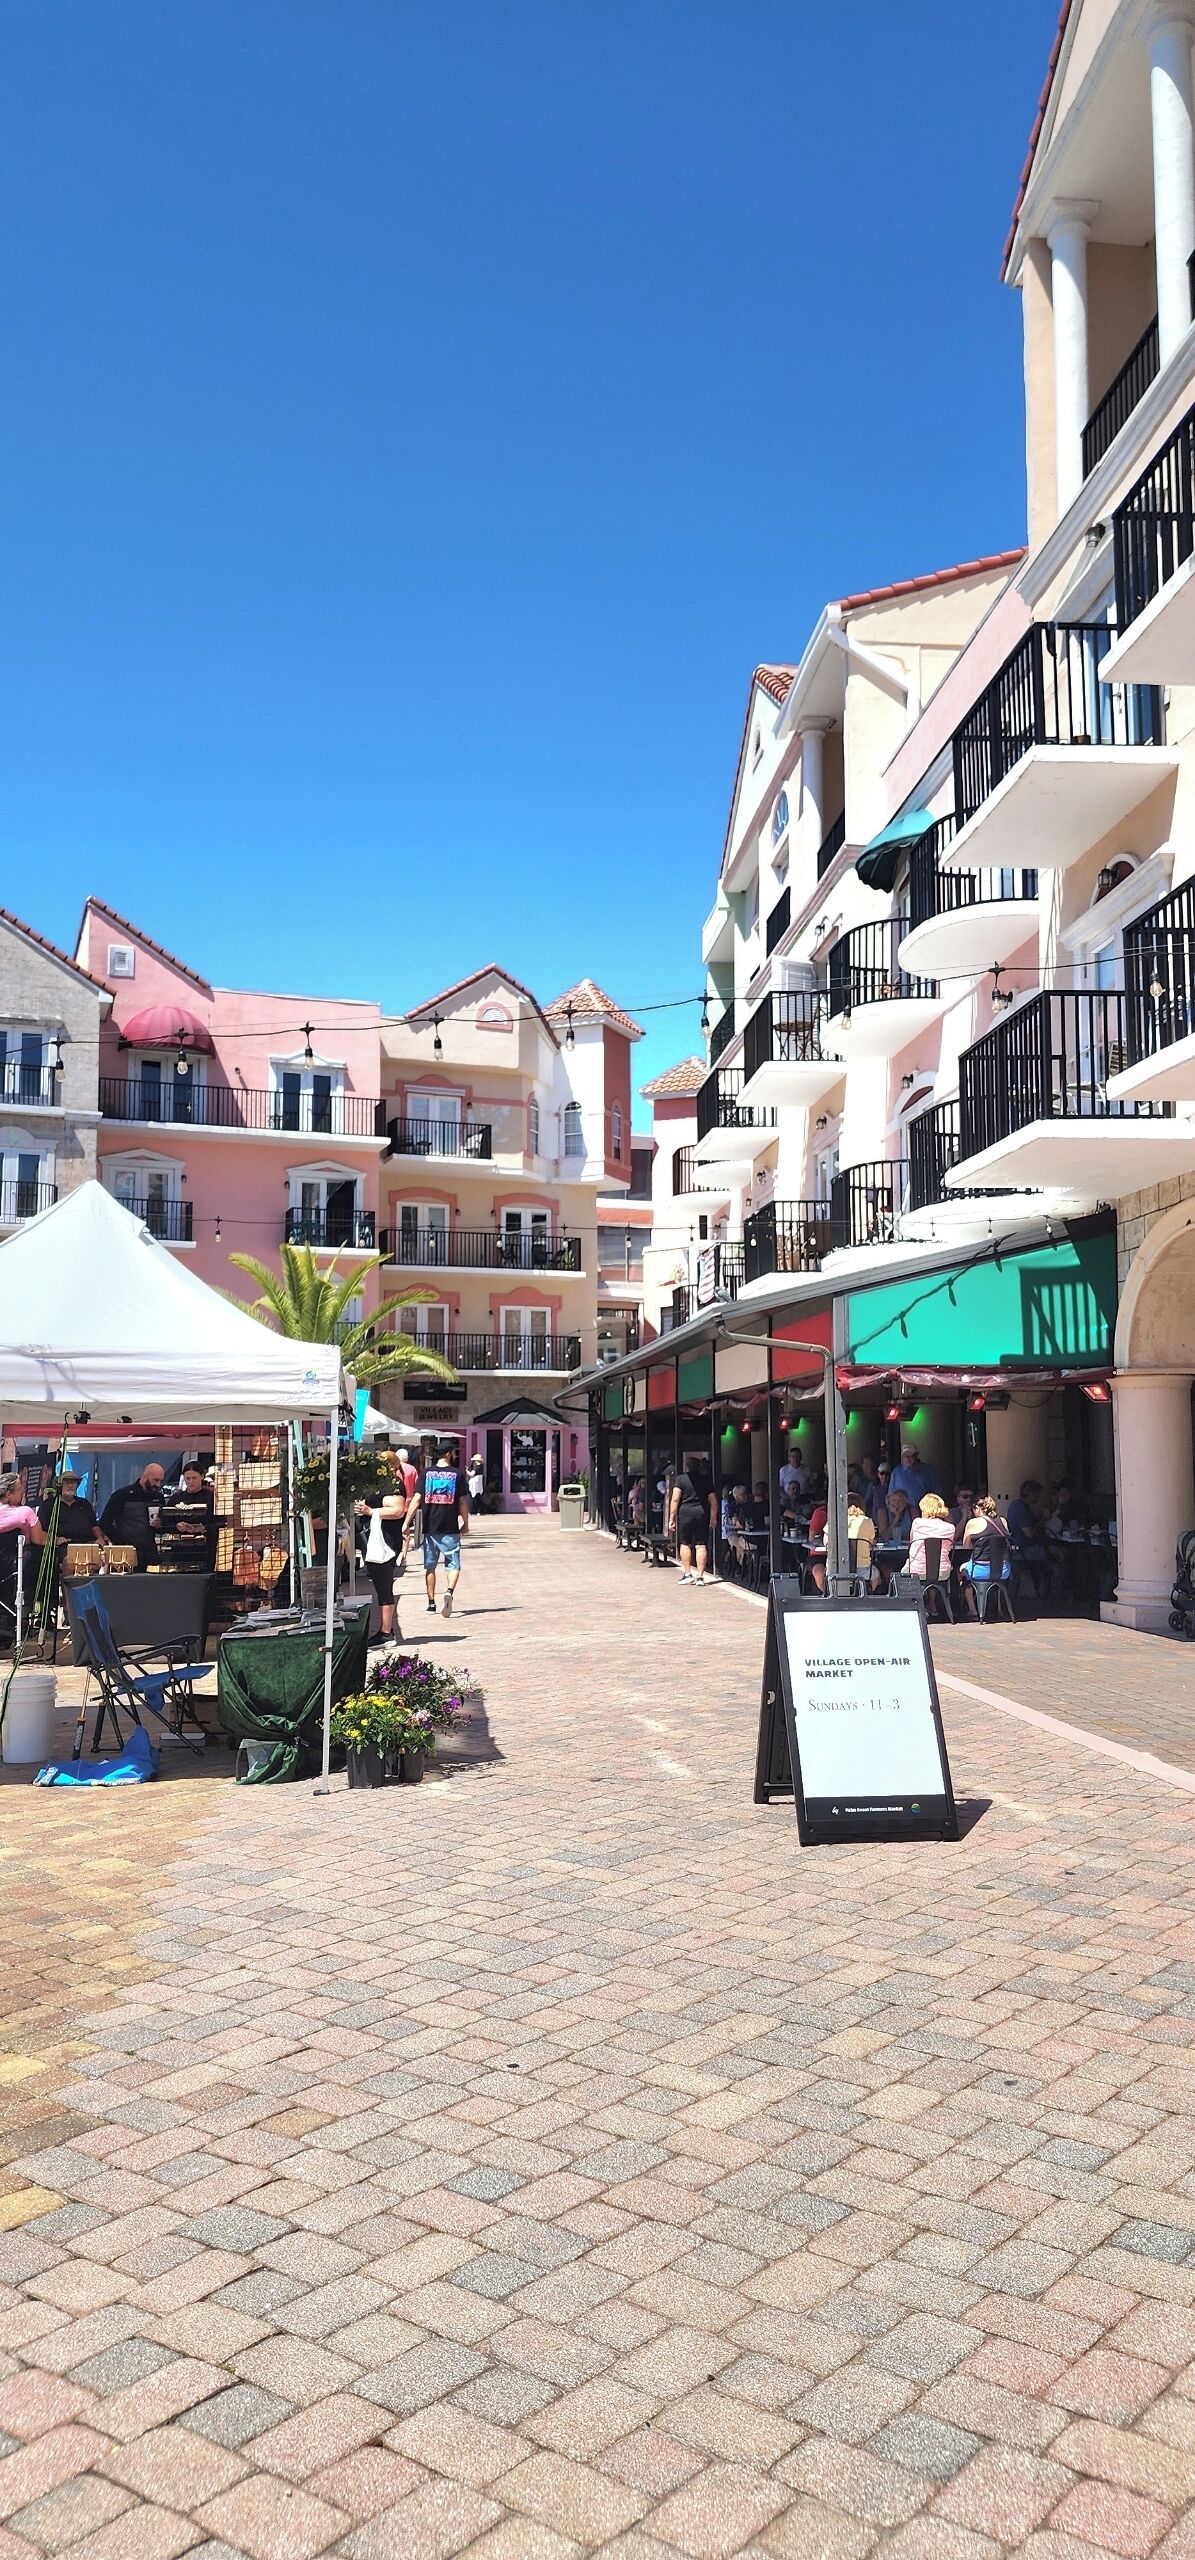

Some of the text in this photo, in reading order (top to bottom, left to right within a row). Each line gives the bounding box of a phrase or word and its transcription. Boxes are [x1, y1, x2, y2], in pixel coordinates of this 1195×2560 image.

[804, 1657, 911, 1667] VILLAGE OPEN-AIR
[805, 1670, 853, 1678] MARKET
